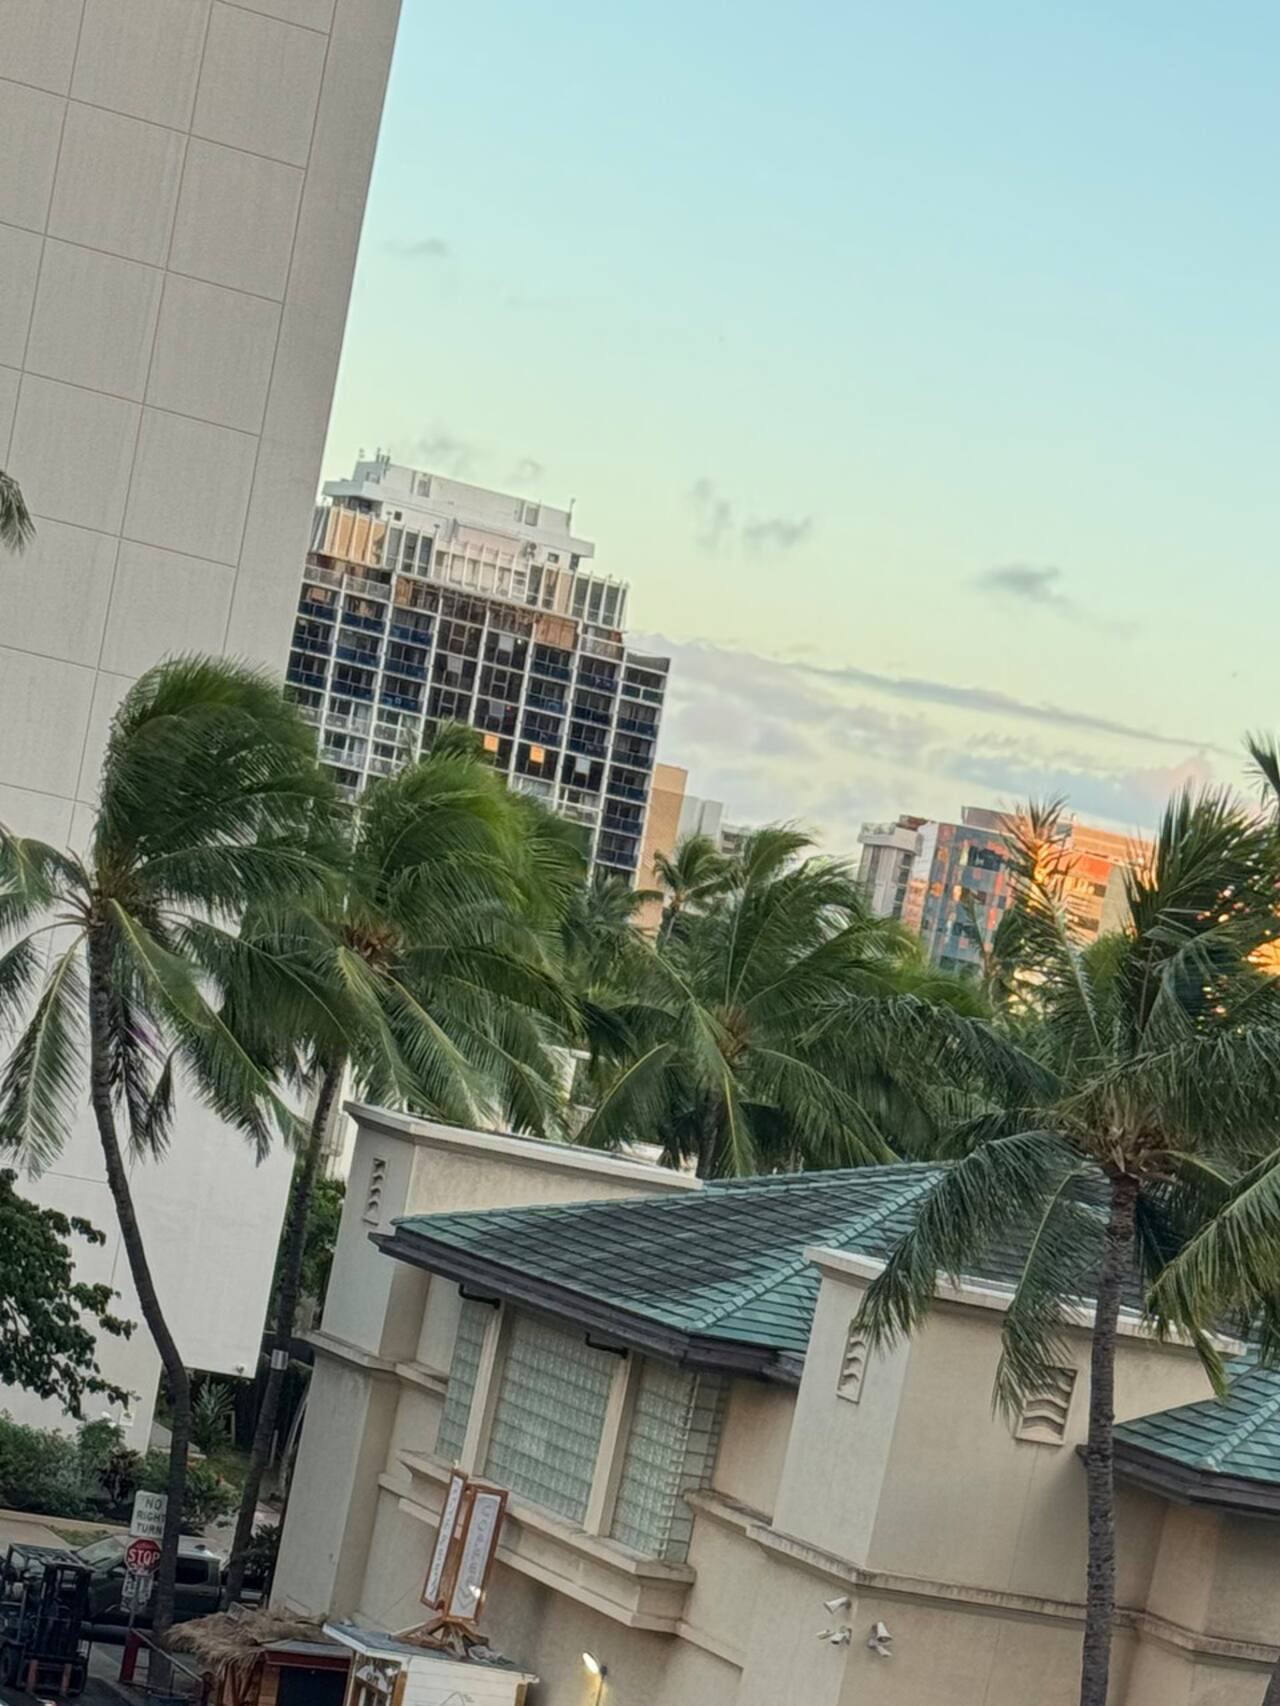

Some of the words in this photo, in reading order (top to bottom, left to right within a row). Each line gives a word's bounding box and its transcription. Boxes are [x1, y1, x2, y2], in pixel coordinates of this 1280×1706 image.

[145, 1498, 162, 1511] NO
[136, 1510, 166, 1522] RIGHT
[136, 1523, 163, 1535] TURN
[127, 1549, 160, 1566] STOP
